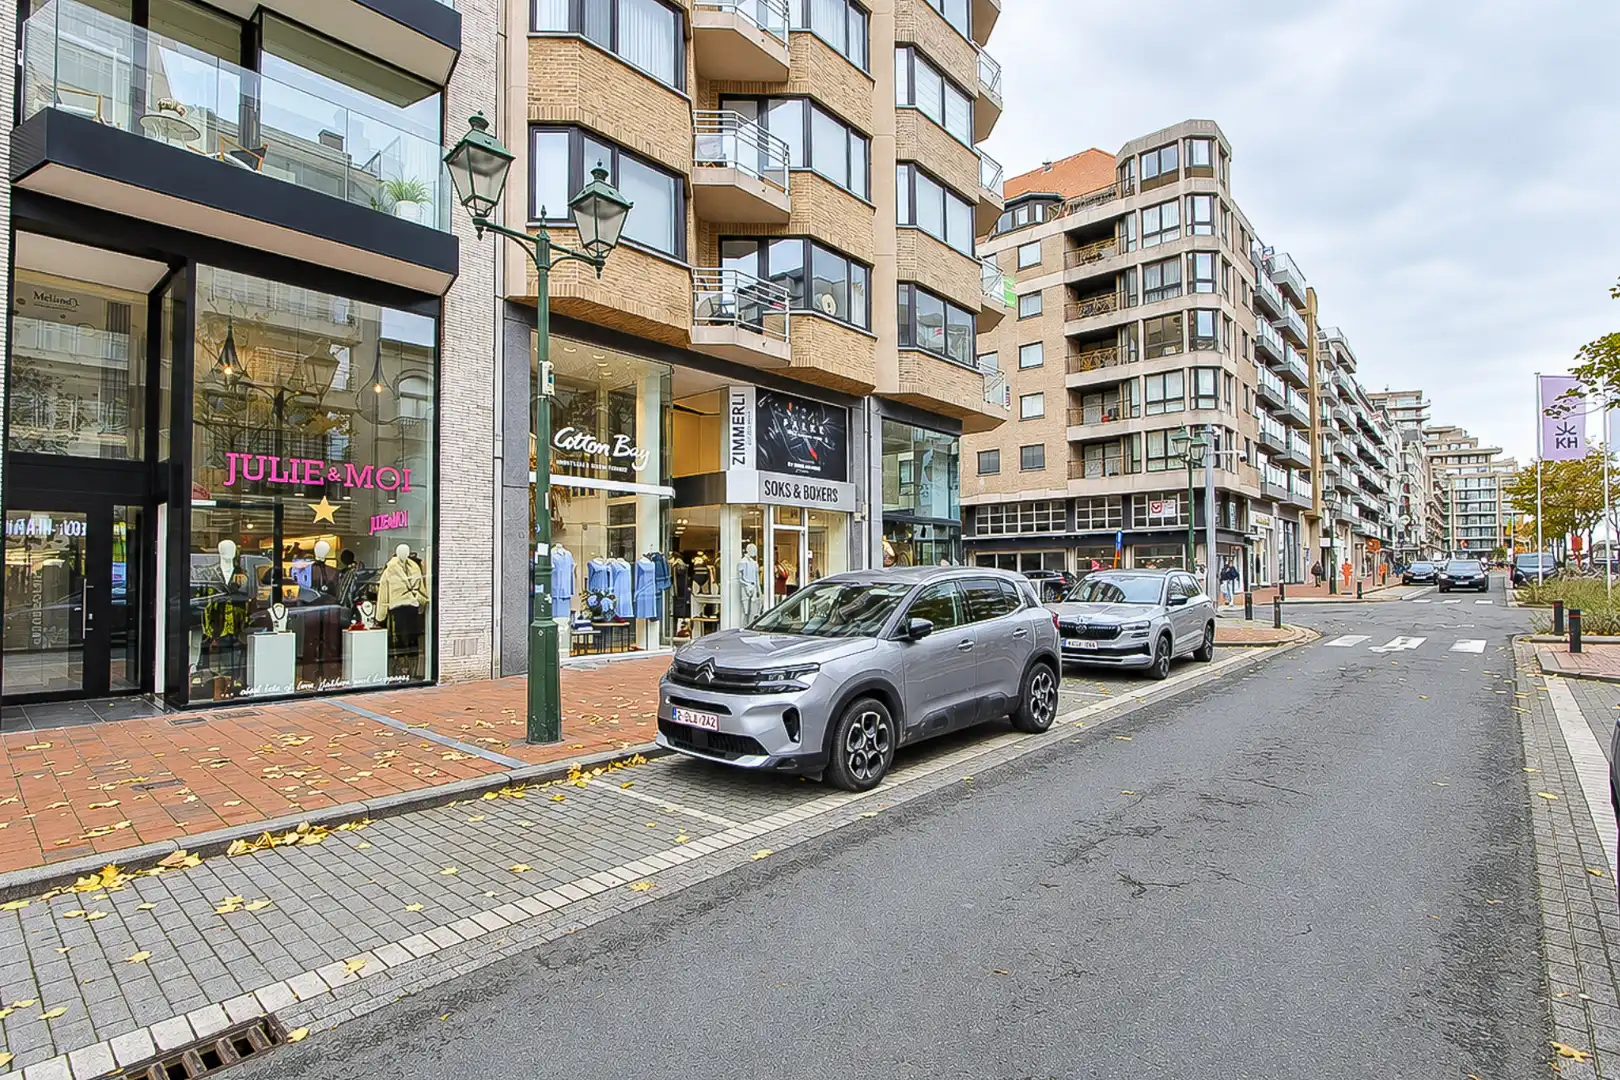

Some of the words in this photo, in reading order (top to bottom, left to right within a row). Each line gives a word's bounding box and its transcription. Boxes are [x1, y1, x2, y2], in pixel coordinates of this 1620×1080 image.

[732, 393, 746, 466] ZIMMERLI
[1556, 437, 1578, 449] KH
[554, 426, 611, 457] Cotton
[612, 434, 651, 471] Bay
[764, 479, 792, 498] SOKS
[793, 484, 802, 499] &
[803, 484, 838, 503] BOXERS
